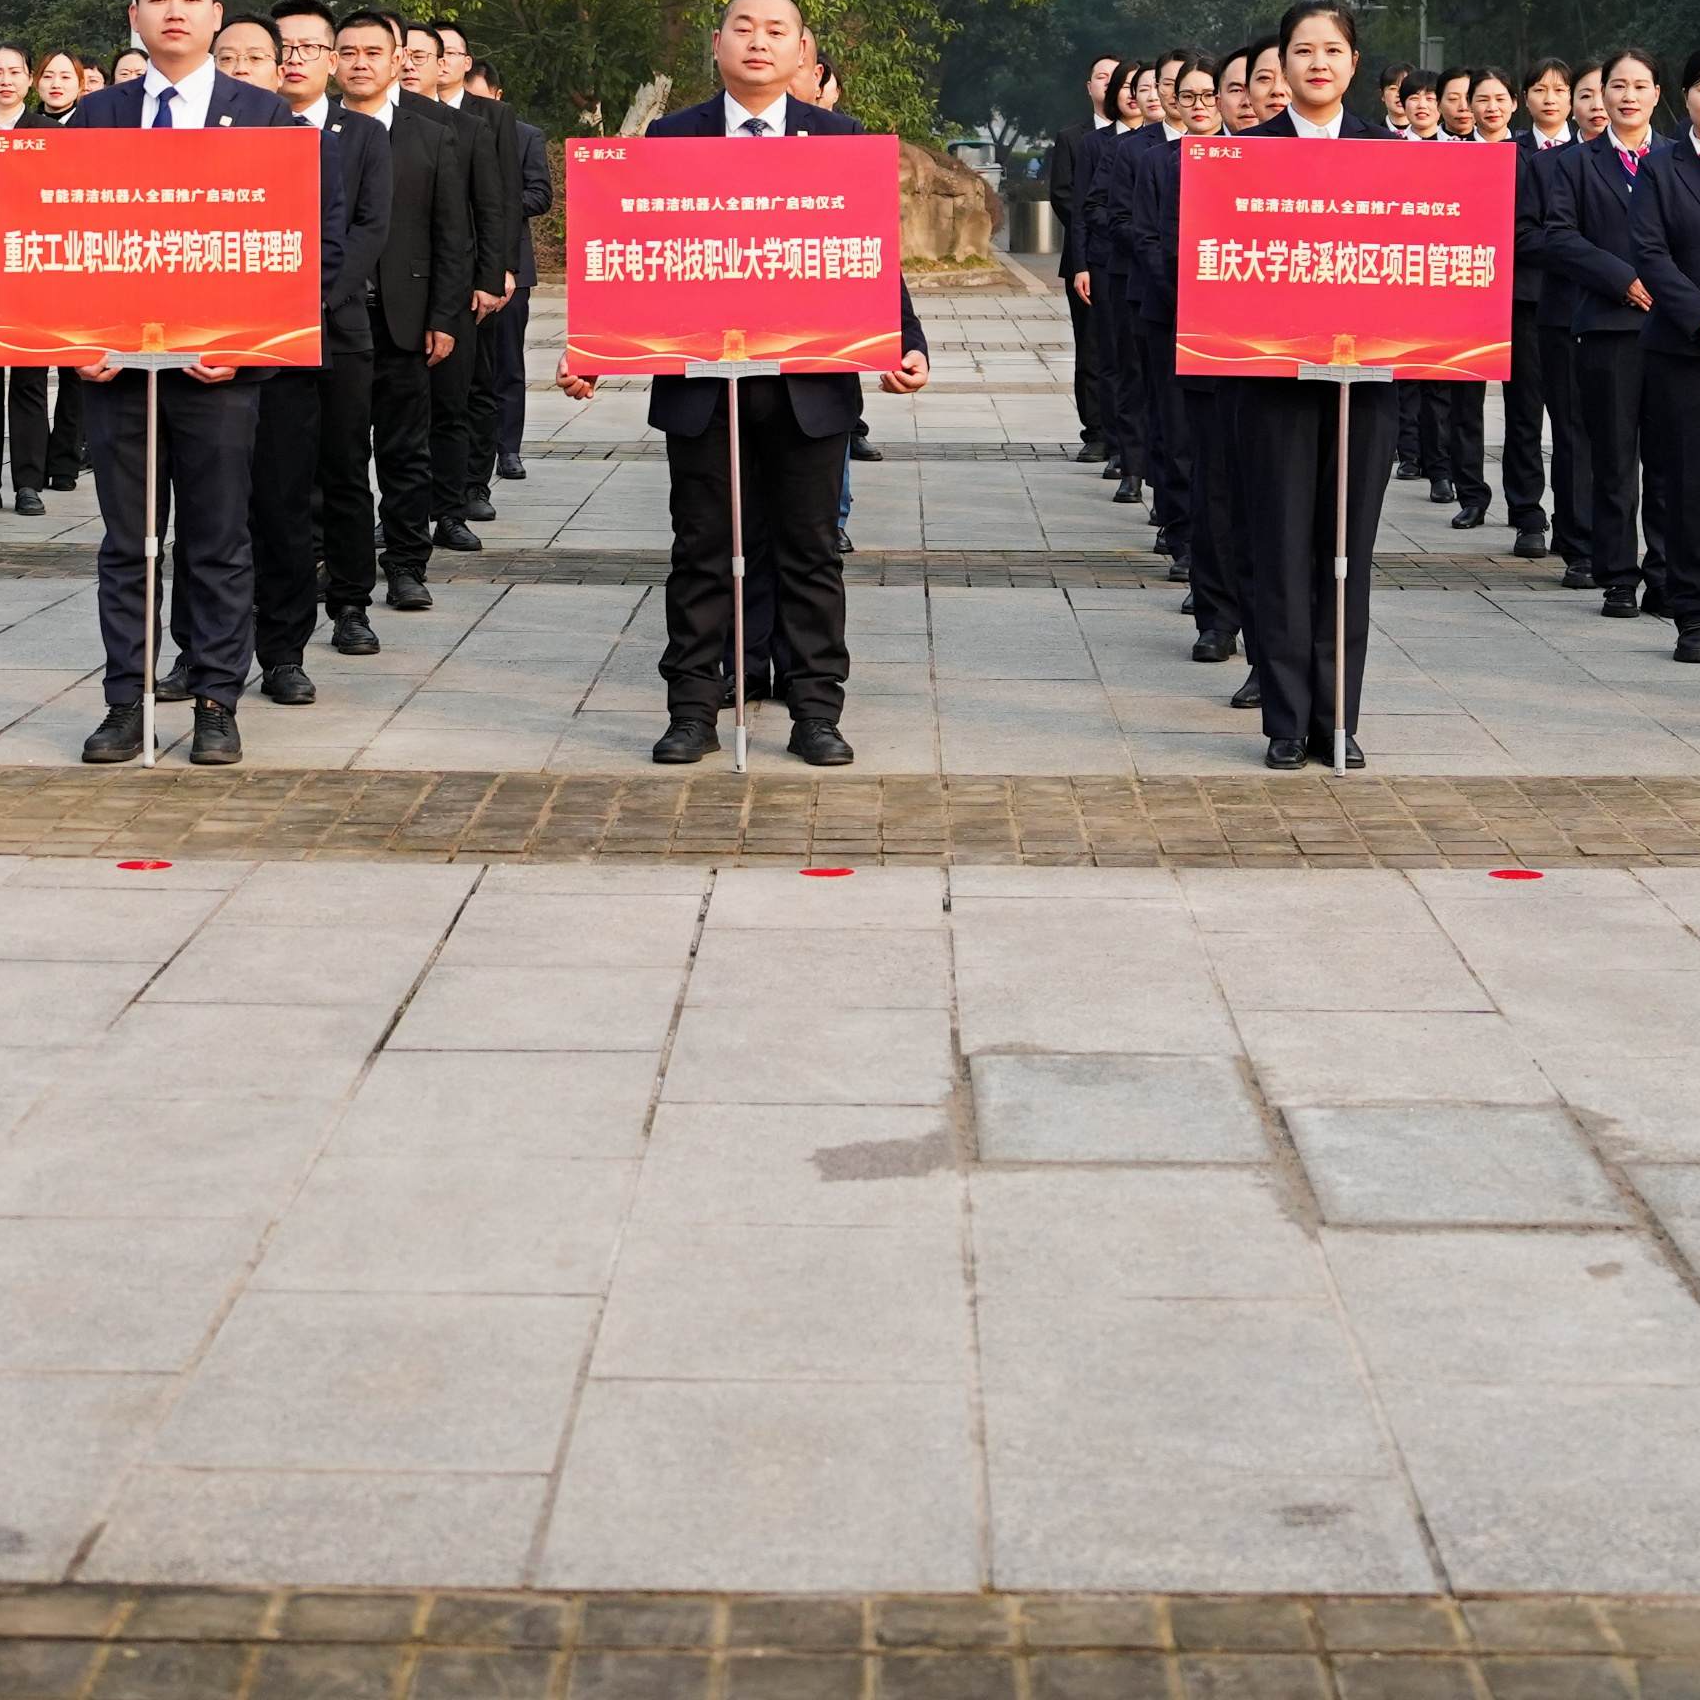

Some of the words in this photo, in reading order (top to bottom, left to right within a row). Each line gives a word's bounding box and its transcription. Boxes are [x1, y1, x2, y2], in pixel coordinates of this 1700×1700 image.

[13, 139, 46, 150] 新大正
[1209, 147, 1242, 158] 新大正
[593, 149, 626, 160] 新大正
[41, 189, 265, 203] 智能清洁机器人全面推广启动仪式
[621, 196, 844, 212] 智能清洁机器人全面推广启动仪式
[1235, 198, 1460, 216] 智能清洁机器人全面推广启动仪式
[4, 229, 302, 273] 重庆工业职业技术学院项目管理部
[585, 236, 881, 282] 重庆电子科技职业大学项目管理部
[1196, 239, 1495, 288] 重庆大学虎溪校区项目管理部
